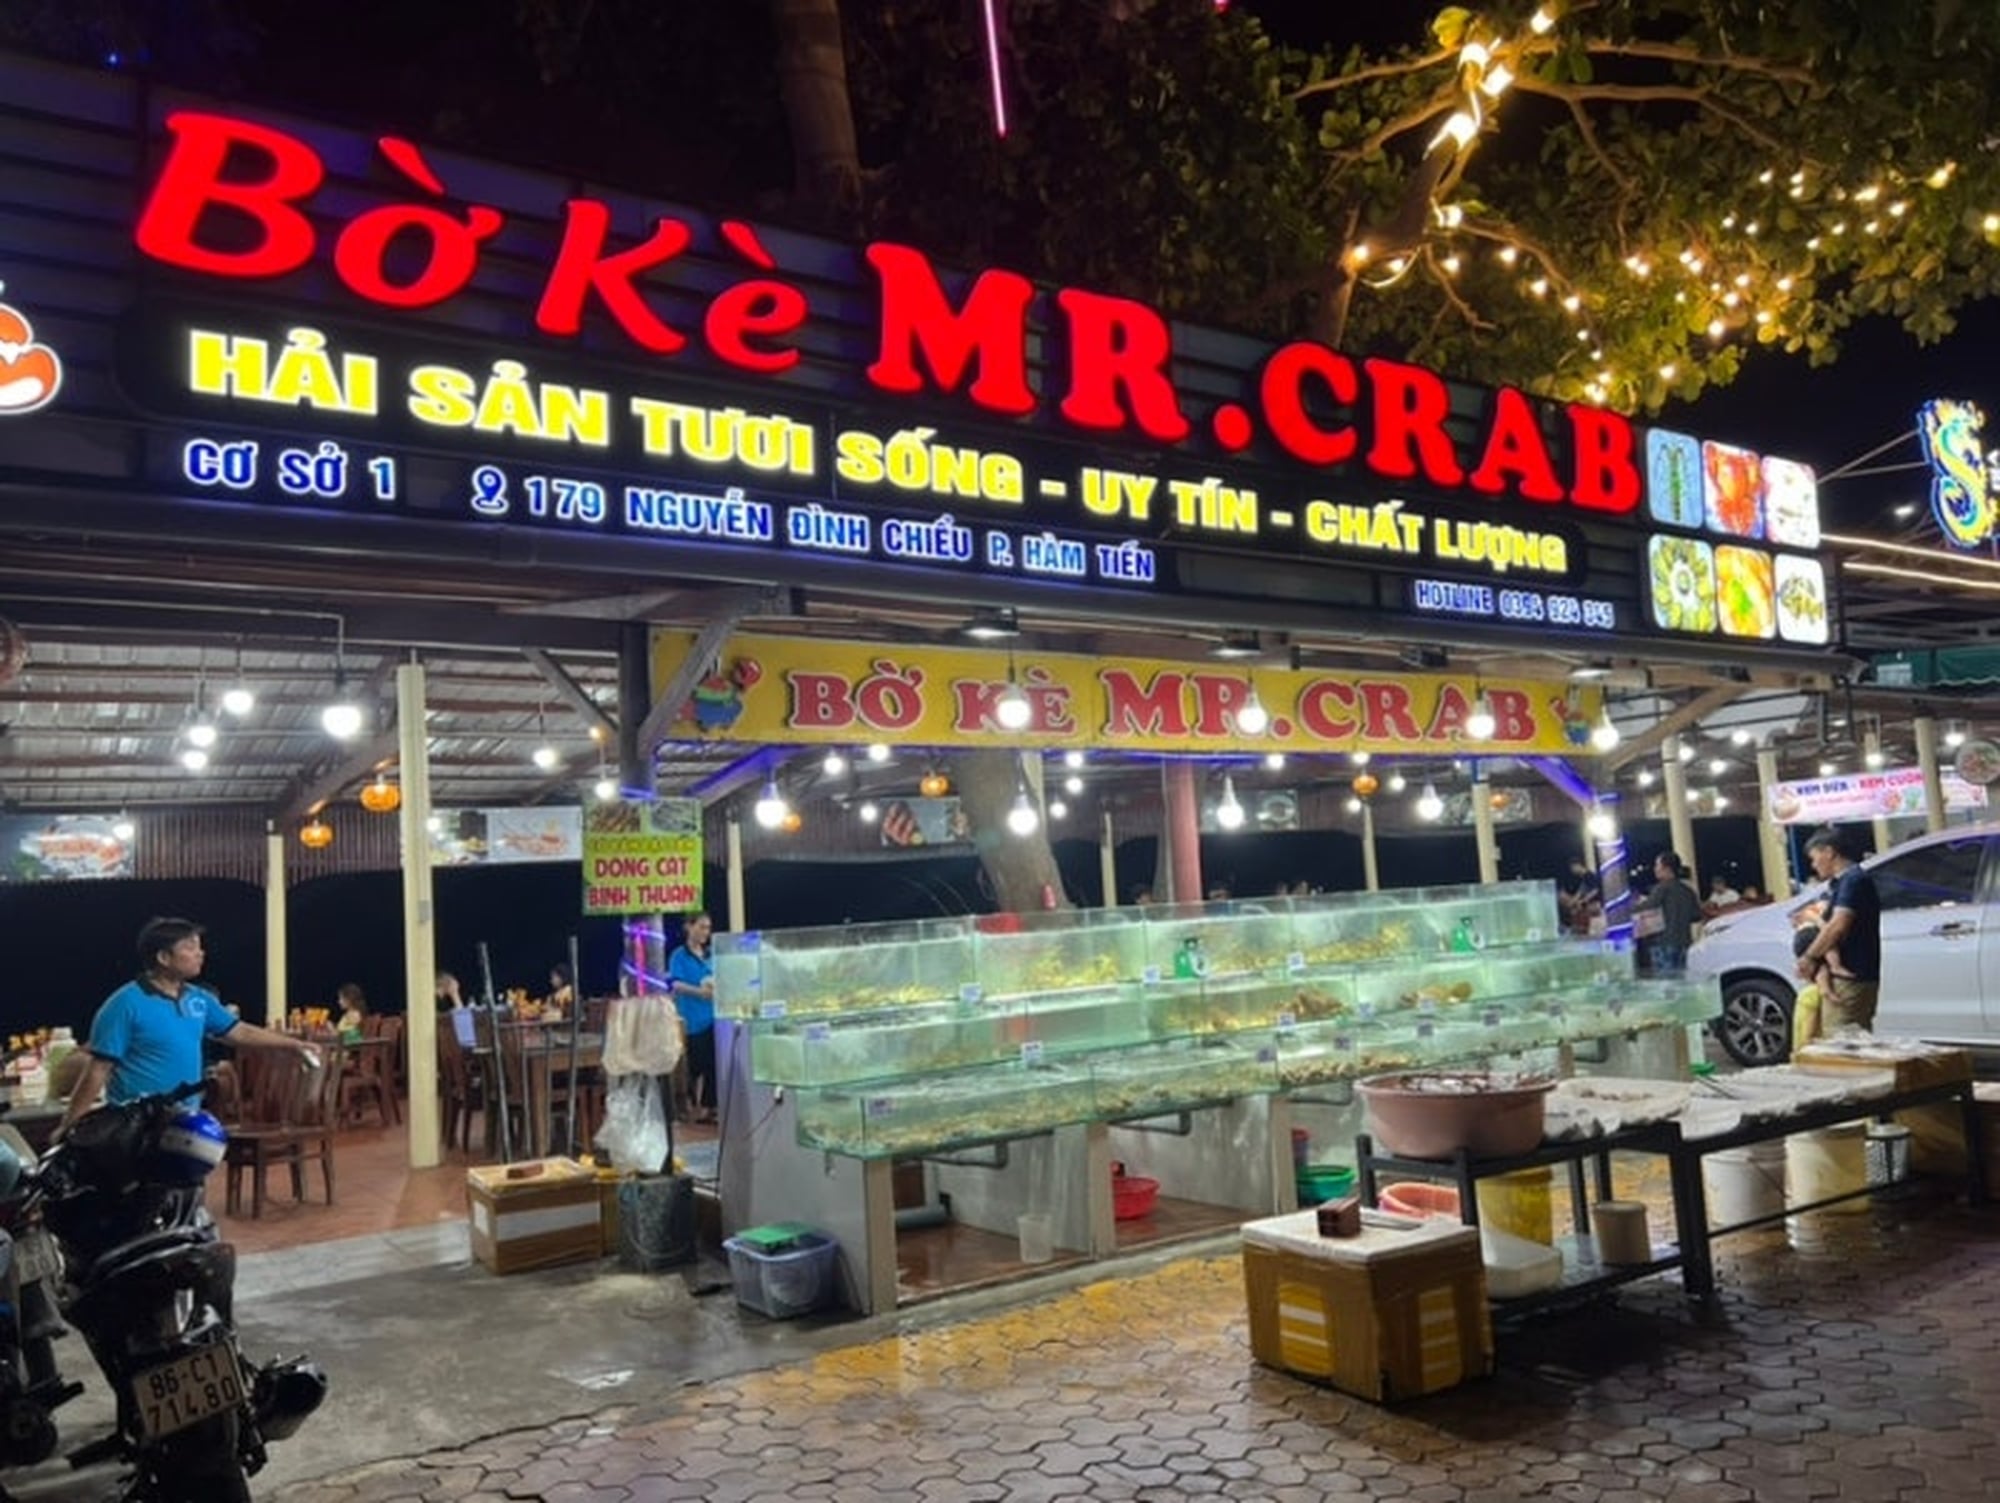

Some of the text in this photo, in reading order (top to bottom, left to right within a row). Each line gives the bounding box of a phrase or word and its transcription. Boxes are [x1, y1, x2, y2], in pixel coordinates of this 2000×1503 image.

[135, 110, 504, 307] Bờ
[536, 199, 809, 373] Kè
[184, 438, 396, 501] CƠ SỞ 1
[189, 328, 379, 416] HẢI
[408, 360, 610, 446] SẢN
[630, 396, 815, 476] TƯƠI
[835, 427, 1025, 504] SỐNG
[1081, 467, 1158, 520] UY
[1169, 475, 1259, 533] TÍN
[1305, 499, 1425, 554] CHẤT
[1434, 517, 1568, 574] LƯỢNG
[525, 475, 607, 523] 179
[624, 486, 773, 541] NGUYỄN
[787, 502, 871, 552] ĐÌNH
[881, 512, 973, 562] CHIỂU
[986, 530, 1015, 567] P.
[1022, 532, 1087, 576] HÀM
[1415, 579, 1495, 614] HOTLINE
[787, 659, 925, 732] BỜ
